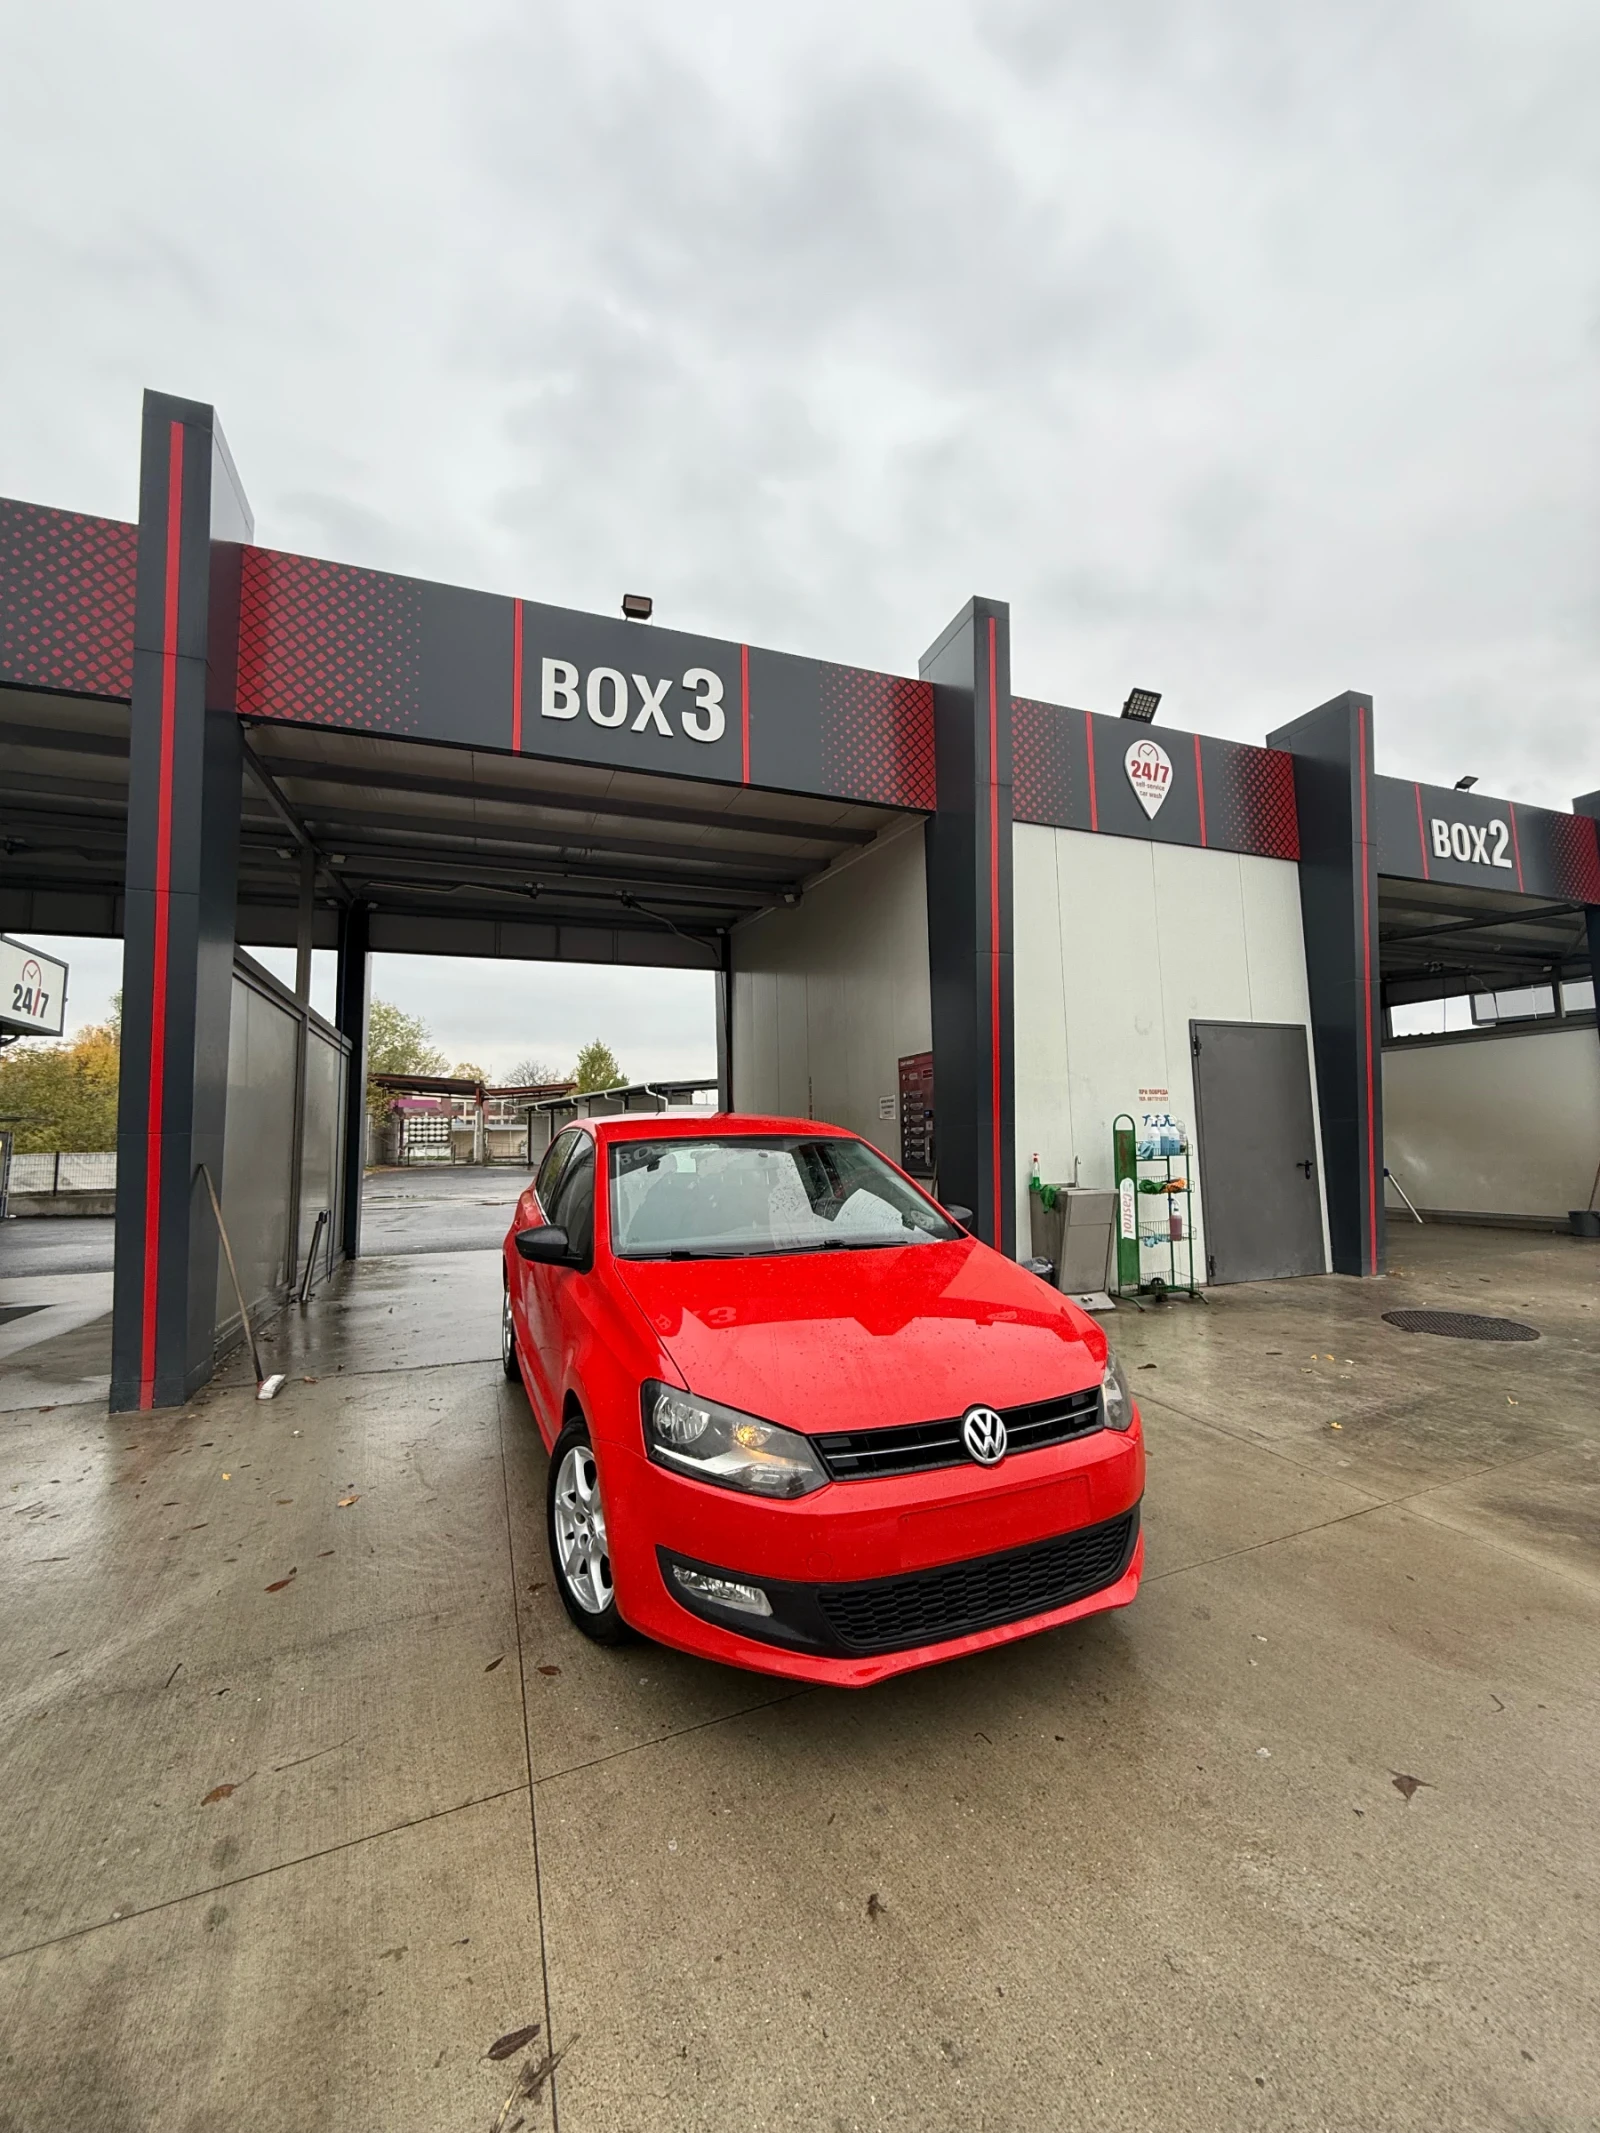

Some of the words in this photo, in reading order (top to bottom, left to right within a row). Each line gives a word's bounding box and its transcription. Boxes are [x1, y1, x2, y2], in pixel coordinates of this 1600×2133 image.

[541, 657, 726, 743] BOX3
[1131, 759, 1170, 784] 24/7
[1136, 781, 1165, 792] self-service
[1430, 818, 1513, 869] BOX2
[12, 983, 50, 1018] 24/7
[1123, 1193, 1134, 1234] Castrol
